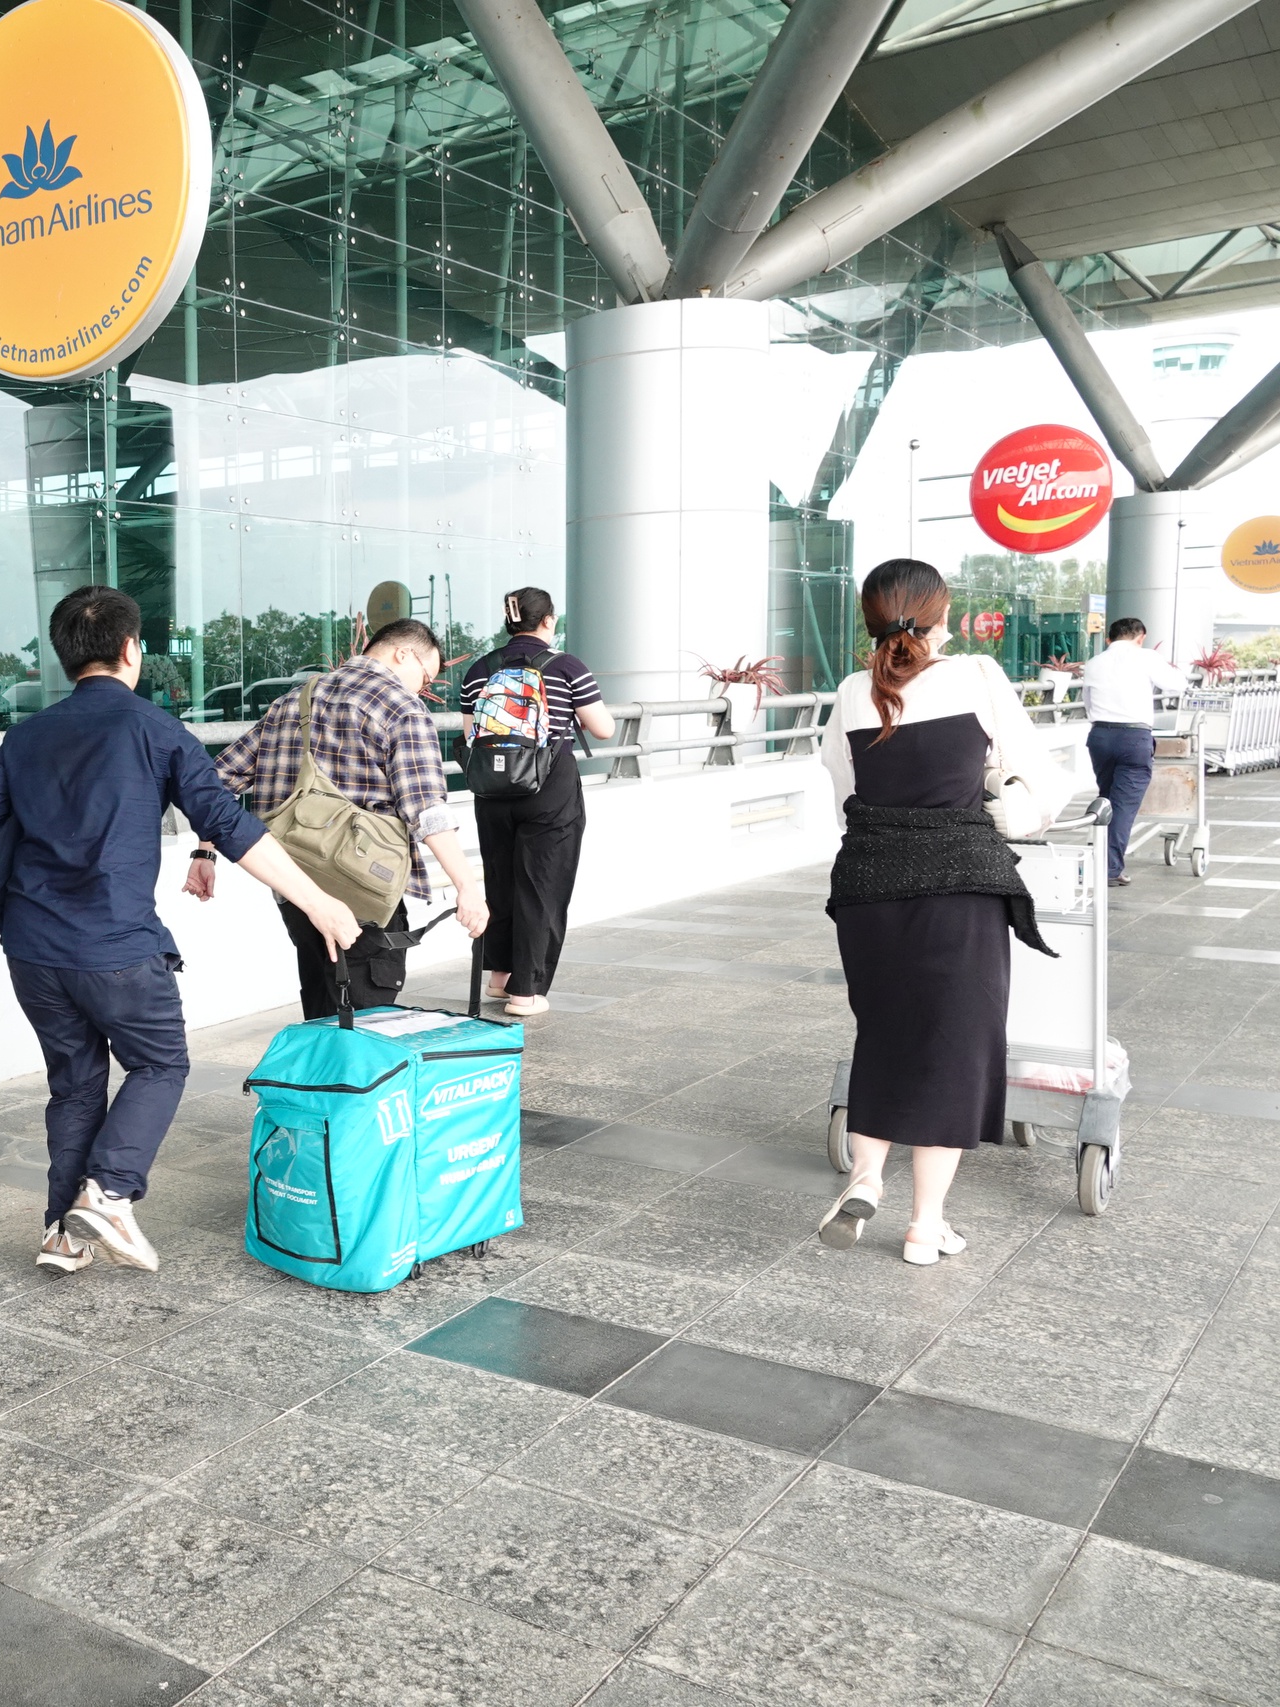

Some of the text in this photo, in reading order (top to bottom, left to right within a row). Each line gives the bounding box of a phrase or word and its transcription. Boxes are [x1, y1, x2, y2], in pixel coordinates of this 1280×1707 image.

[47, 189, 153, 235] Airlines
[1018, 483, 1099, 507] Air.com
[434, 1069, 510, 1105] VITALPACK
[447, 1132, 502, 1163] URGENT
[286, 1194, 318, 1205] DOCUMENT
